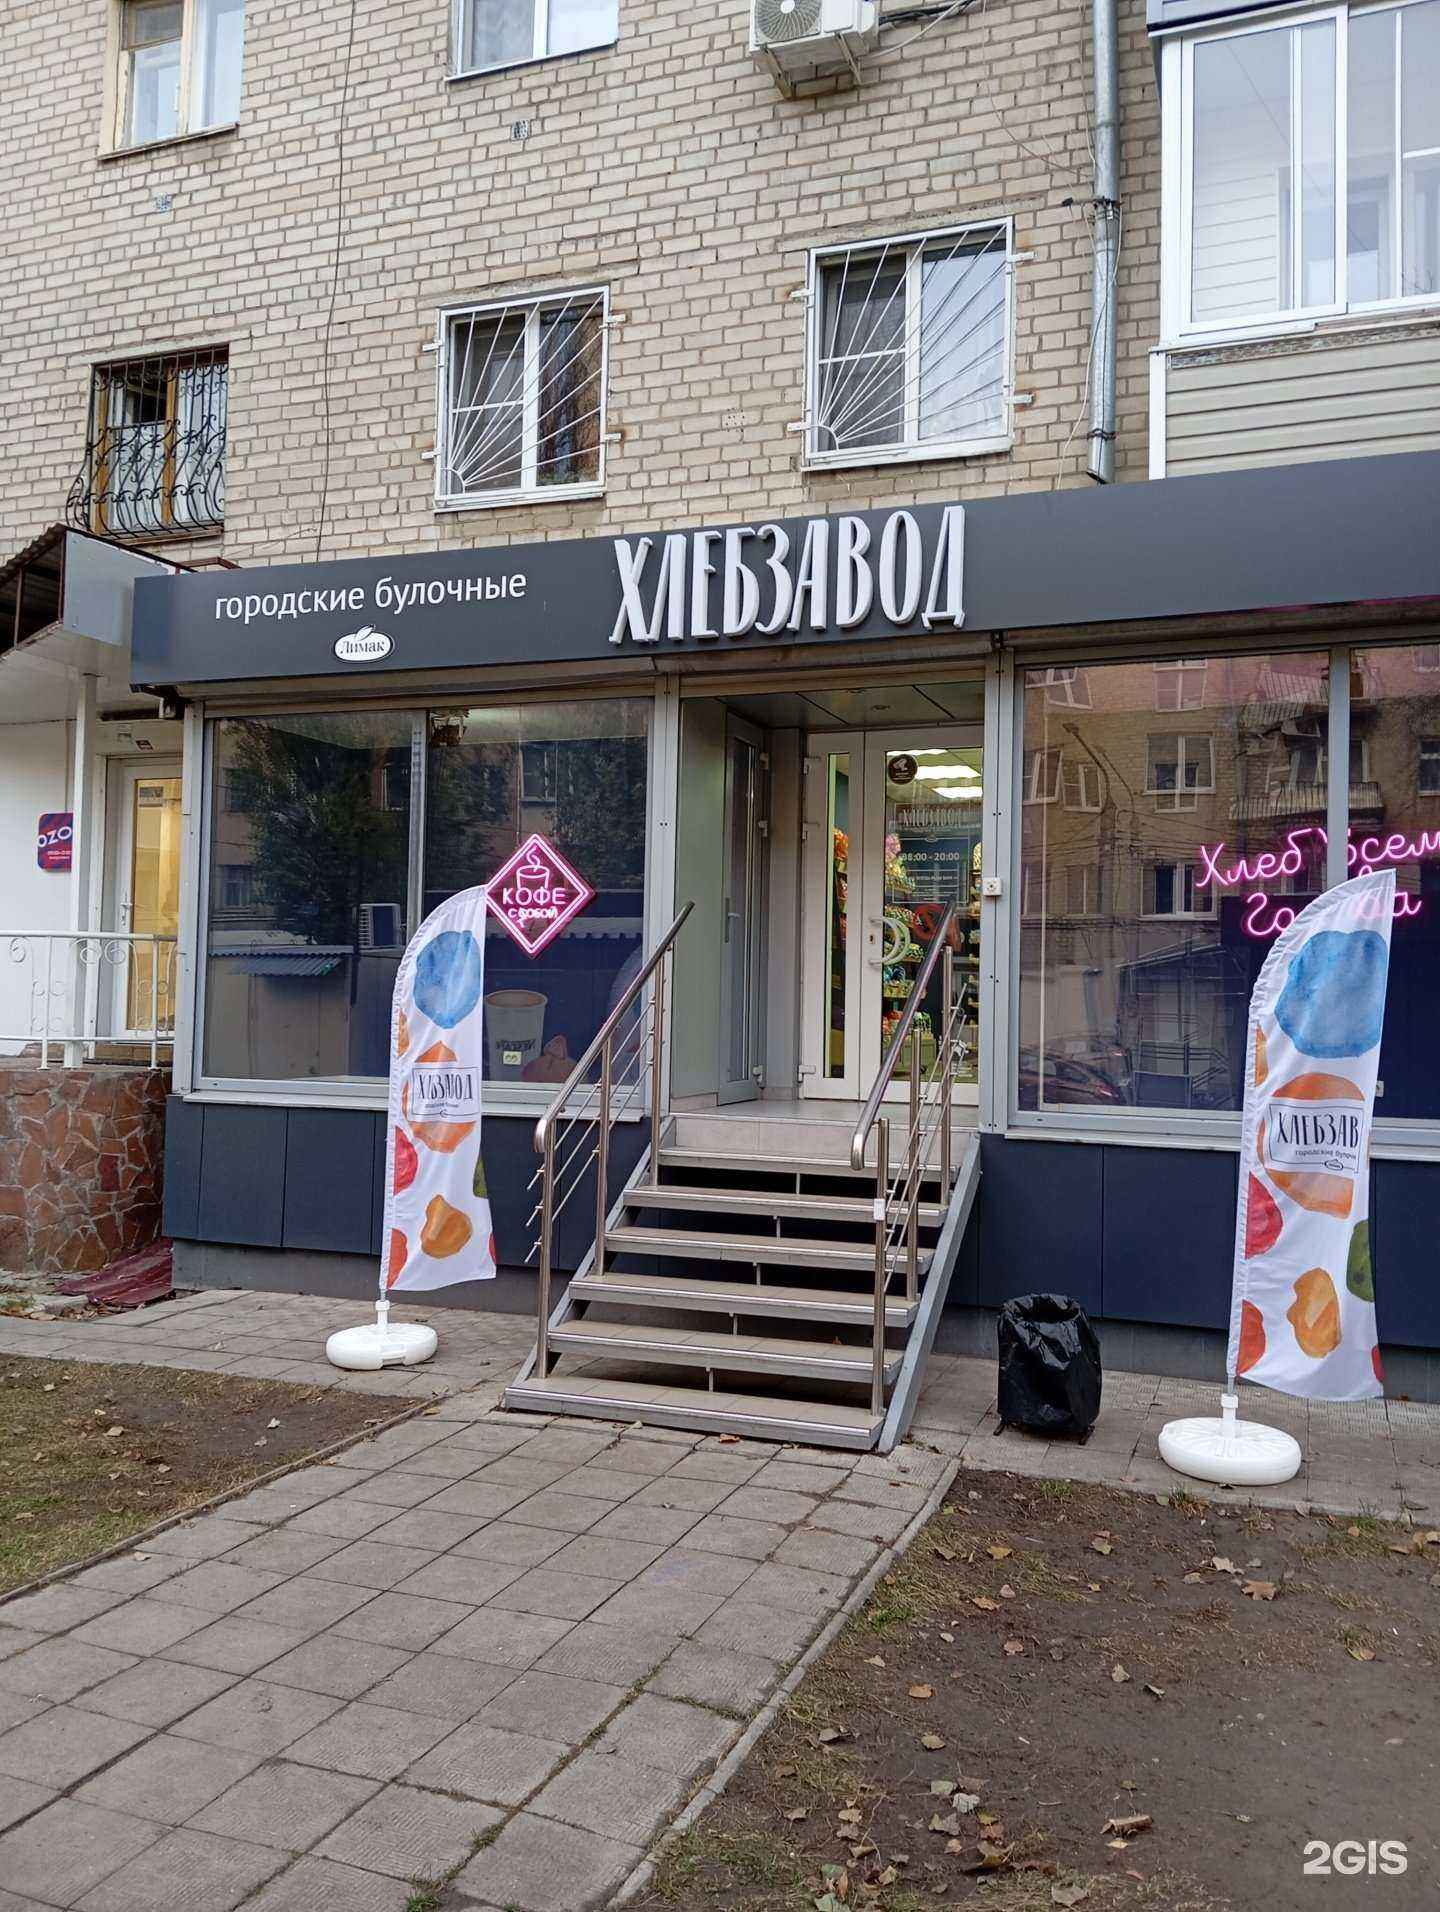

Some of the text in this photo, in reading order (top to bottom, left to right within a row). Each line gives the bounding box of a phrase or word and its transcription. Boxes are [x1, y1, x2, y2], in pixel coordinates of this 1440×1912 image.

[609, 505, 966, 645] ХЛЕБЗАВОД
[215, 573, 528, 624] городские булочные
[340, 639, 386, 655] Лимак
[37, 826, 72, 848] OZO
[934, 851, 960, 861] 20:00
[1195, 827, 1313, 887] Хлеб
[502, 886, 567, 906] КОФЕ
[1277, 1111, 1359, 1148] ХЛЕБЗАВ
